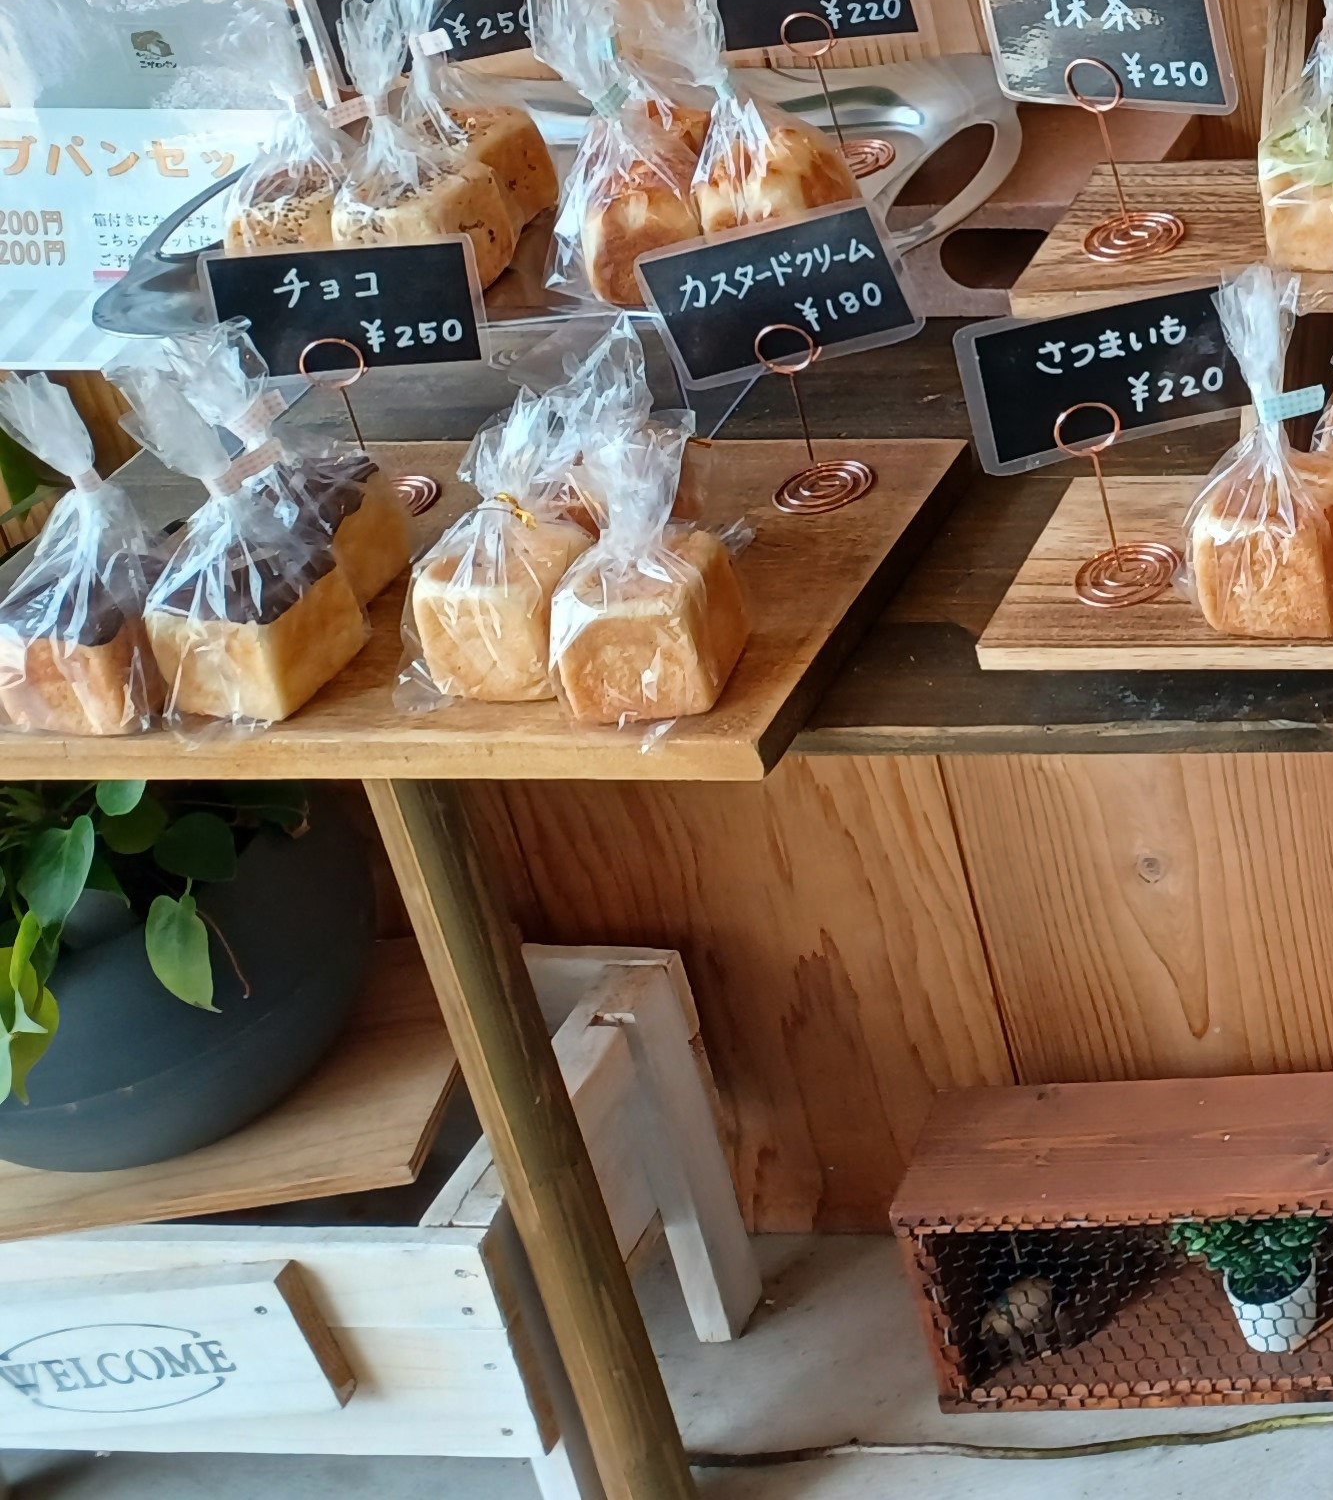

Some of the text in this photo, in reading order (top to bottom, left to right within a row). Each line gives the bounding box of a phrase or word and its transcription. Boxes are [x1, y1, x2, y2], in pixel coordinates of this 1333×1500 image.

[1121, 51, 1209, 88] ¥250
[272, 267, 380, 309] チョコ
[679, 238, 876, 312] カスタードクリーム
[794, 281, 883, 332] ¥180
[359, 317, 463, 353] ¥250
[1035, 314, 1188, 375] さつまいも
[1127, 366, 1224, 413] ¥220
[0, 1339, 237, 1397] WELCOME
